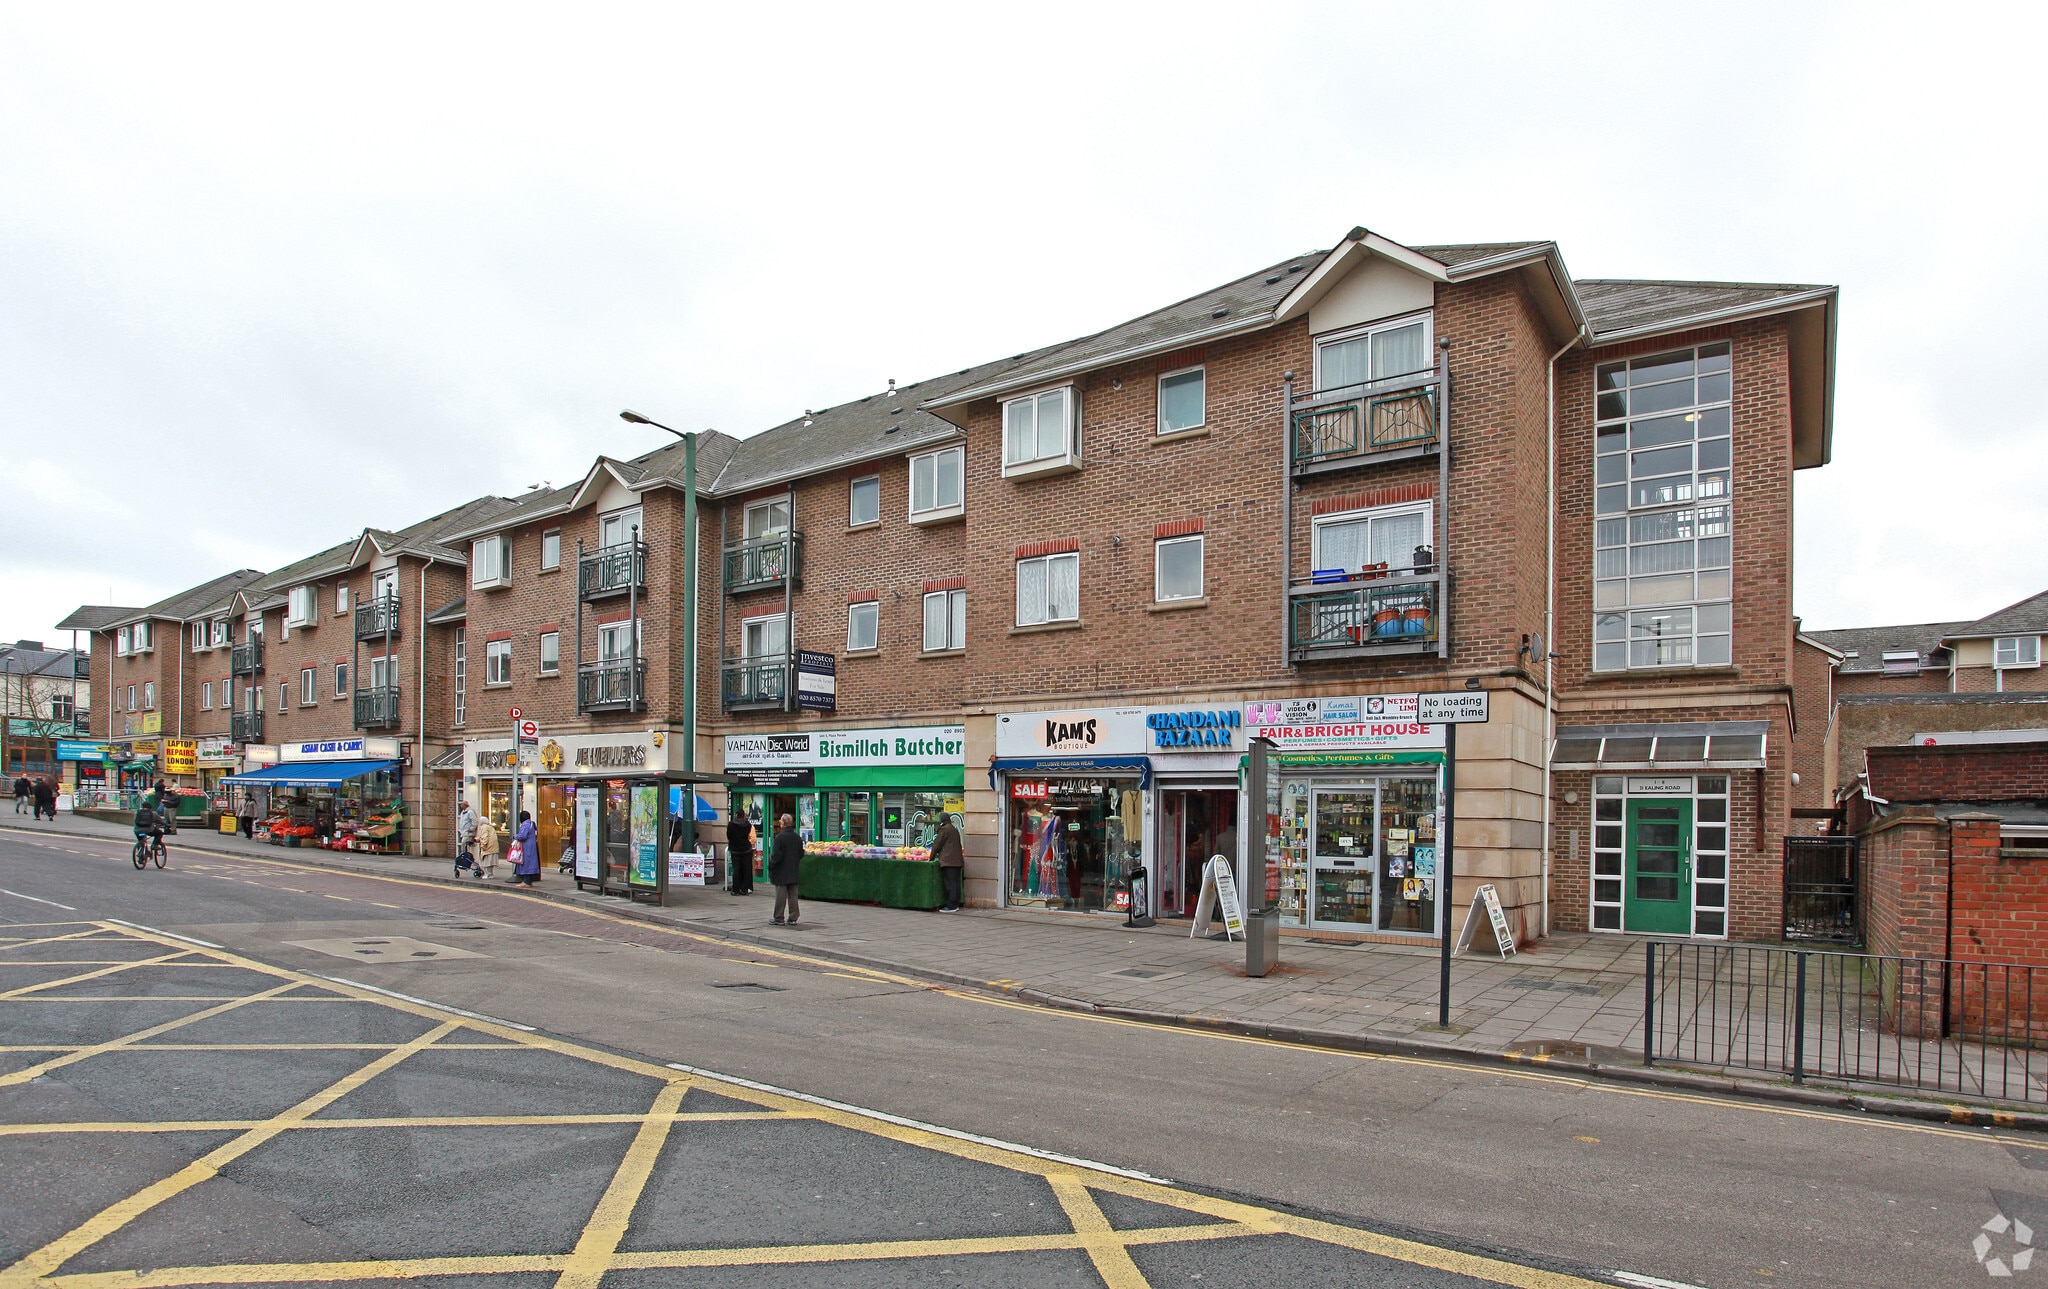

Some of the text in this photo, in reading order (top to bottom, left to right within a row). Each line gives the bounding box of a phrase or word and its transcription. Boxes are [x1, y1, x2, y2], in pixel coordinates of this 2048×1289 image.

[800, 653, 834, 663] Investco
[1424, 696, 1482, 707] No loading
[512, 708, 521, 718] D
[1422, 707, 1484, 719] at any time
[1146, 710, 1239, 730] CHANDANI
[1046, 718, 1097, 748] KAM'S
[1370, 723, 1431, 736] HOUSE
[167, 740, 193, 748] LAPTOP
[1155, 728, 1231, 747] BAZAAR
[301, 743, 319, 753] ASIAN
[319, 742, 337, 752] CASH
[337, 742, 343, 752] &
[727, 738, 808, 752] VAHIZAN Disc World
[819, 736, 962, 758] Bismillah Butcher
[1053, 742, 1089, 750] BOUTIQUE
[166, 748, 195, 757] REPAIRS
[575, 744, 647, 768] JEWELLERS
[1014, 783, 1045, 797] SALE
[1116, 893, 1130, 906] SA
